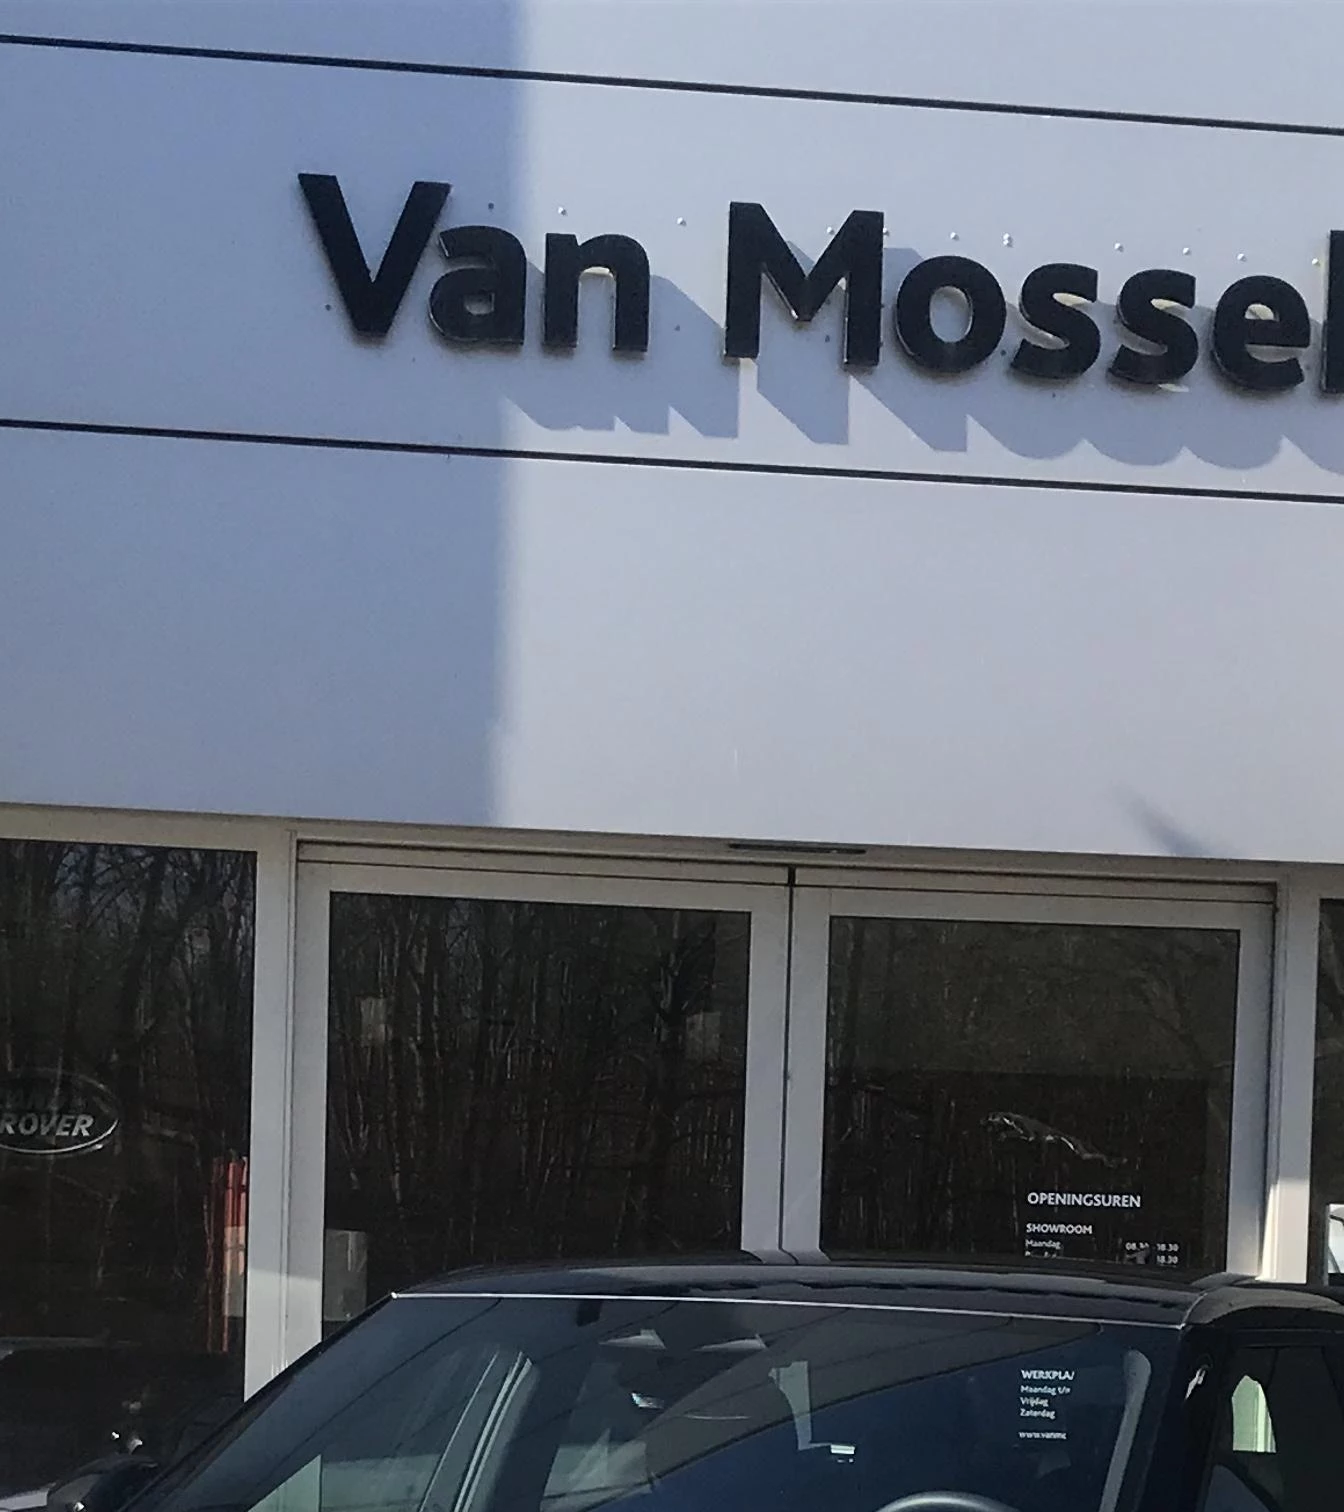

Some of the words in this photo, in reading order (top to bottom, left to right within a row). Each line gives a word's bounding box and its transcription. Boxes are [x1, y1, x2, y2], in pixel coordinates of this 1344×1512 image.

[296, 171, 650, 352] Van
[1027, 1192, 1141, 1207] OPENINGSUREN
[1026, 1222, 1093, 1235] SHOWROOM
[1024, 1239, 1062, 1250] Maandag
[1020, 1408, 1056, 1420] Zaterdag
